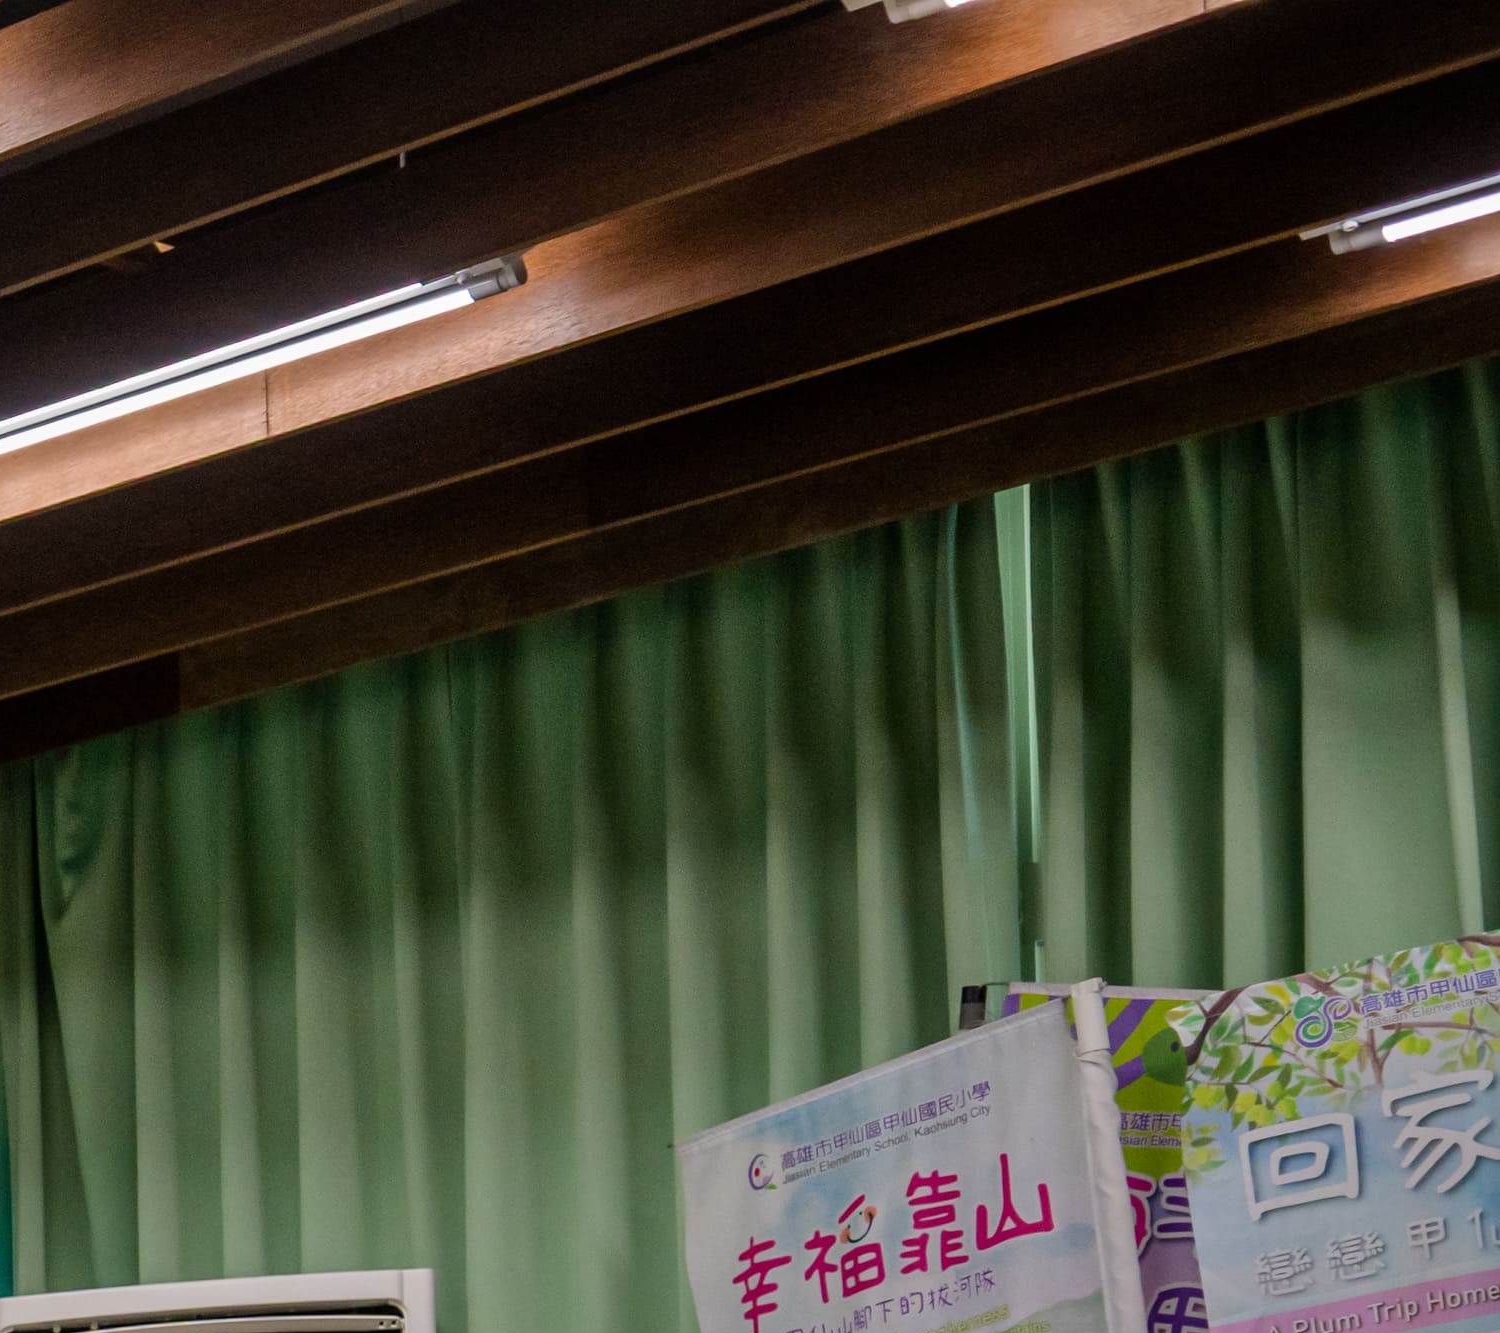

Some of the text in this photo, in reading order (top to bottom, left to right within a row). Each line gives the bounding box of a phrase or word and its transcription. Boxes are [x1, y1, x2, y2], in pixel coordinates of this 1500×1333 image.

[1360, 968, 1500, 1015] 高雄市甲仙區
[780, 1080, 991, 1171] 高雄市甲仙區甲仙國民小學
[819, 1145, 872, 1175] Elementary
[913, 1110, 969, 1138] Kaohsiung
[970, 1103, 992, 1121] City
[1367, 1300, 1421, 1325] Trip
[1426, 1282, 1500, 1315] Home
